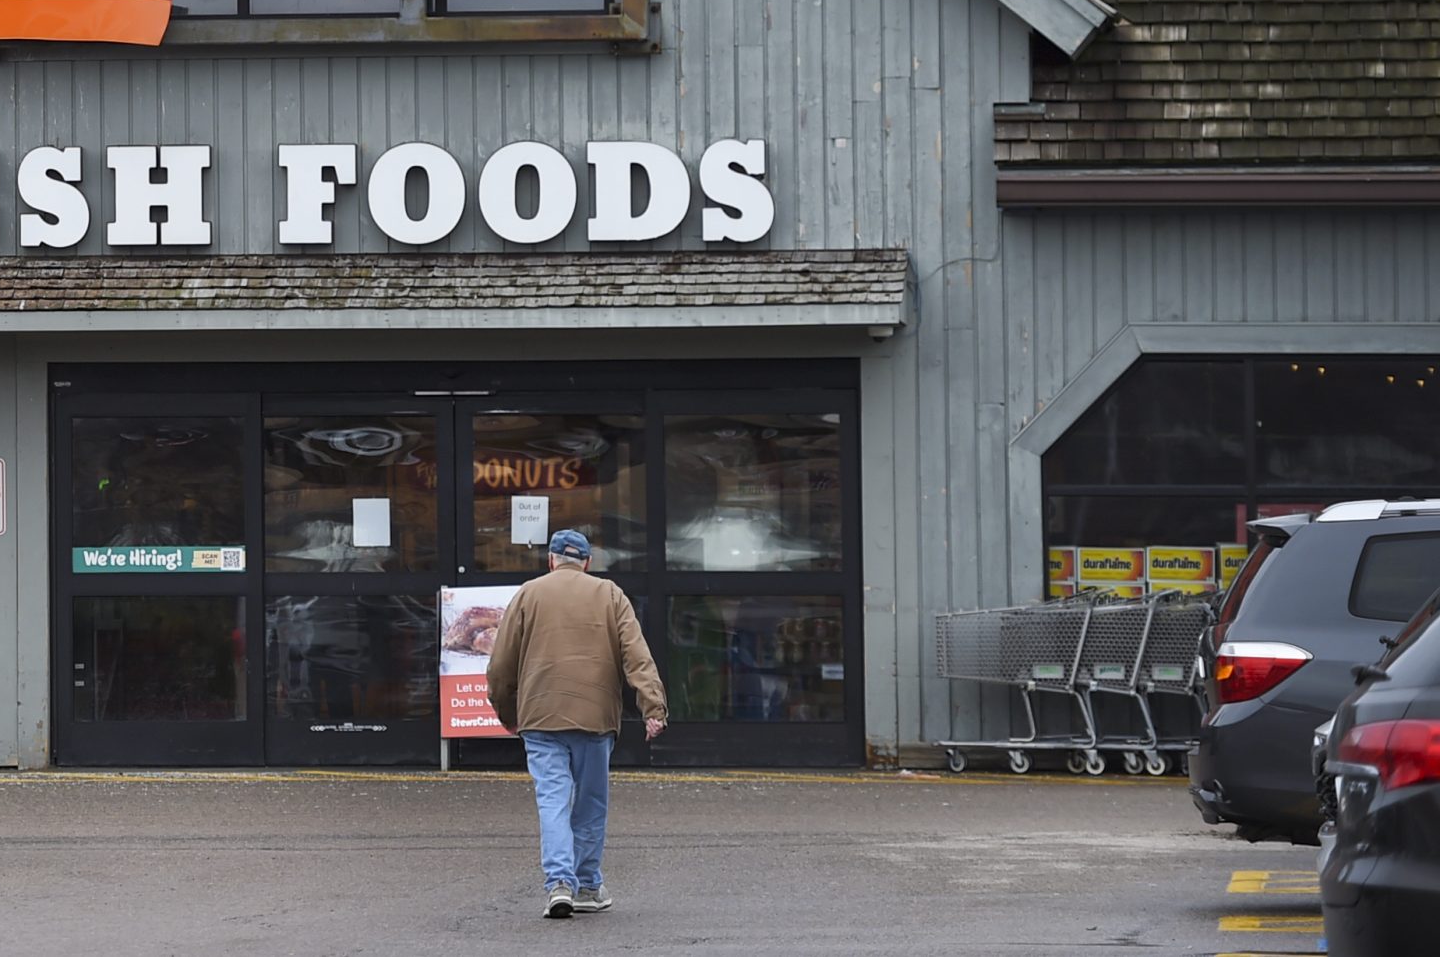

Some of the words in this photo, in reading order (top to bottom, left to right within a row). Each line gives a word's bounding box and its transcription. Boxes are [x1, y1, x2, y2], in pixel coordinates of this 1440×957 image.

[278, 138, 777, 246] FOODS
[473, 457, 582, 490] DONUTS
[518, 502, 531, 511] Out
[533, 502, 541, 511] of
[519, 514, 540, 523] order
[83, 549, 126, 567] We're
[129, 549, 183, 571] Hiring!
[1083, 557, 1132, 570] duraflame
[1152, 556, 1201, 570] duraflame
[456, 683, 472, 693] Let
[451, 698, 466, 708] Do
[468, 698, 484, 707] the
